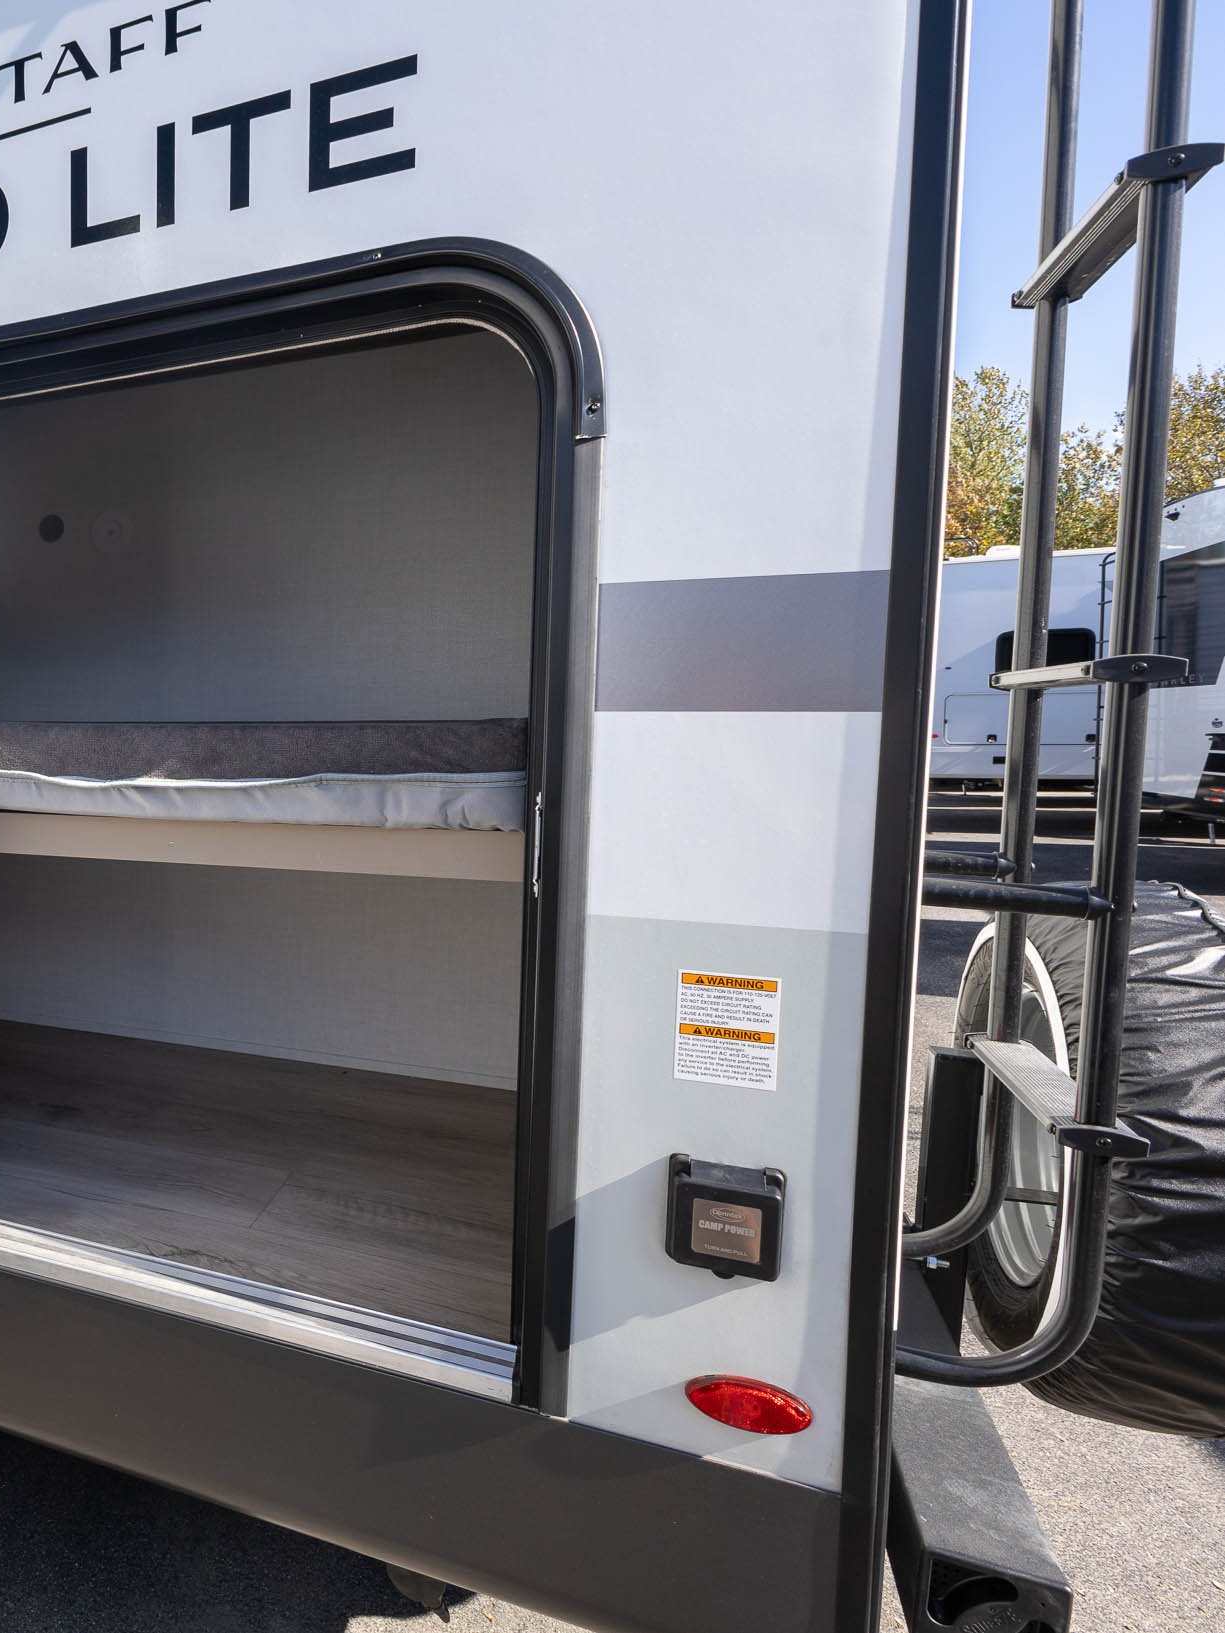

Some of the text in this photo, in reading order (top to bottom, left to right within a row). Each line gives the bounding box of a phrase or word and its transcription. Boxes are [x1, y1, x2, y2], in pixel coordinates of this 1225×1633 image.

[70, 53, 418, 248] LITE
[707, 977, 764, 989] WARNING
[704, 1027, 761, 1041] WARNING
[748, 1043, 774, 1051] equipped
[738, 1059, 769, 1068] performing
[698, 1220, 755, 1237] CAMP POWER
